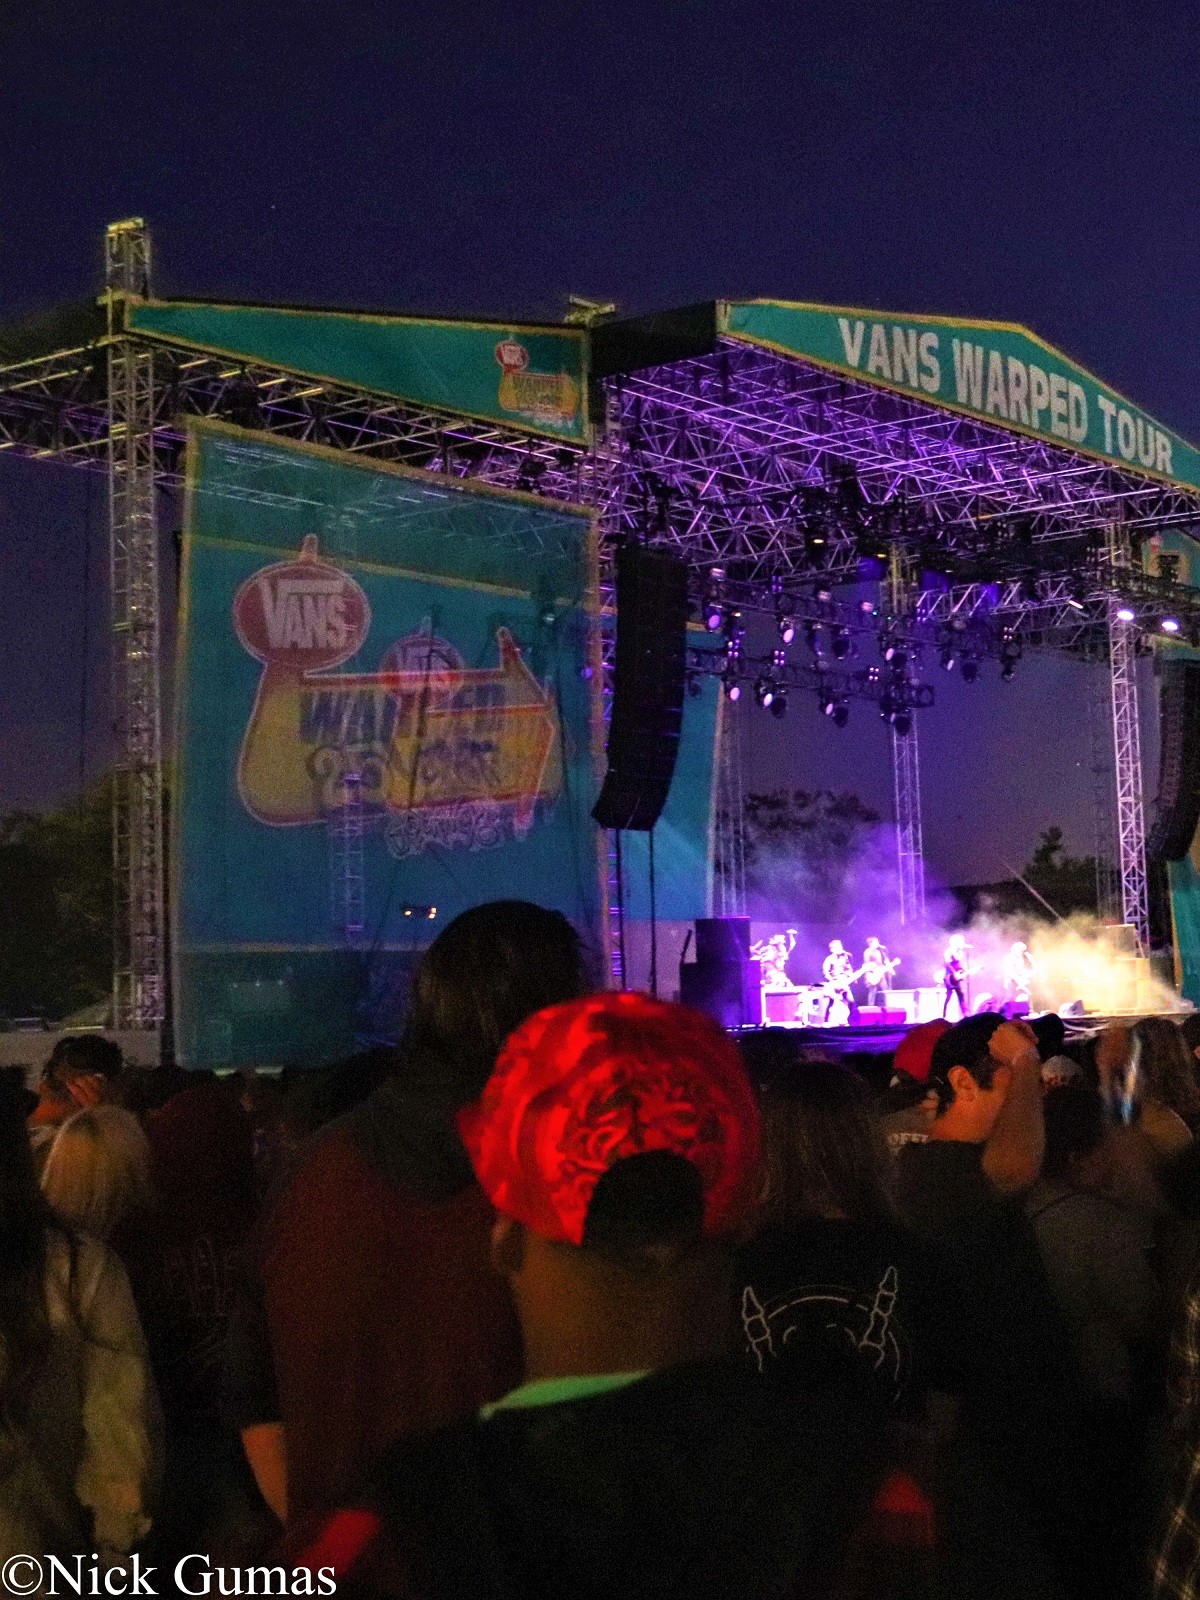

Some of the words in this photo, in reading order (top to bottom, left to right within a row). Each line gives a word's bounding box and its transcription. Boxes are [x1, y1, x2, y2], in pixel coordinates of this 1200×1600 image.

[838, 318, 941, 394] VANS
[952, 338, 1088, 443] WARPED
[1097, 394, 1174, 475] TOUR
[259, 577, 348, 649] VANS
